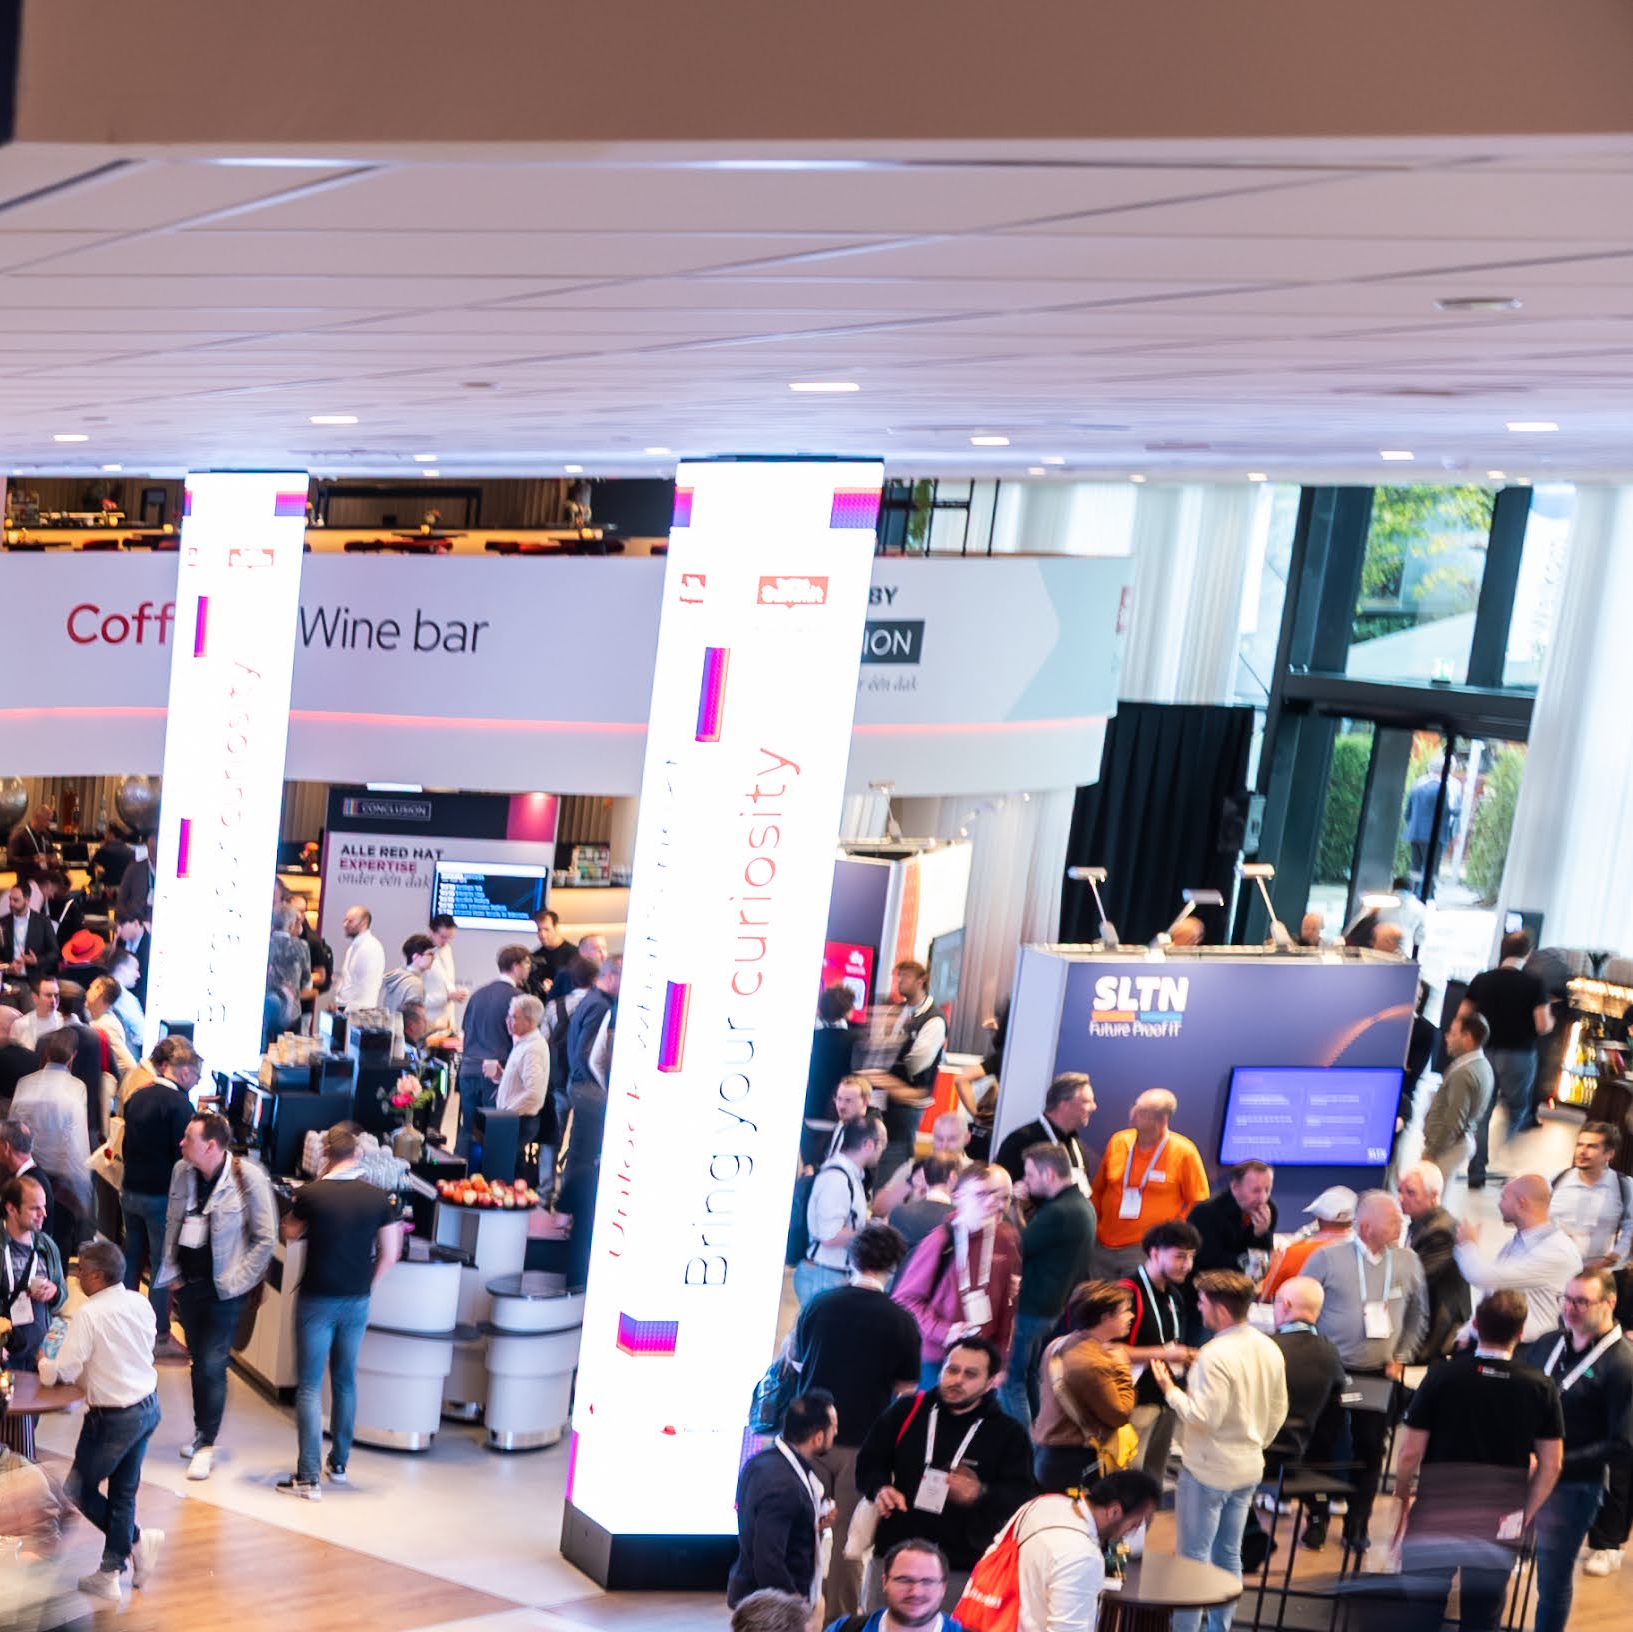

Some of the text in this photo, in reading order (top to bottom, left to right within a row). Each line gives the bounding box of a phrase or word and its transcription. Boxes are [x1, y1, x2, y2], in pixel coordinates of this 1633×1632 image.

[300, 605, 401, 651] Wine
[413, 608, 490, 653] bar
[340, 843, 444, 861] ALLE RED HAT
[339, 858, 417, 874] EXPERTISE
[337, 871, 376, 886] onder
[406, 871, 431, 890] dak
[1092, 975, 1190, 1013] SLTN
[684, 747, 801, 1286] Bring your curiosity
[1089, 1020, 1131, 1037] Future
